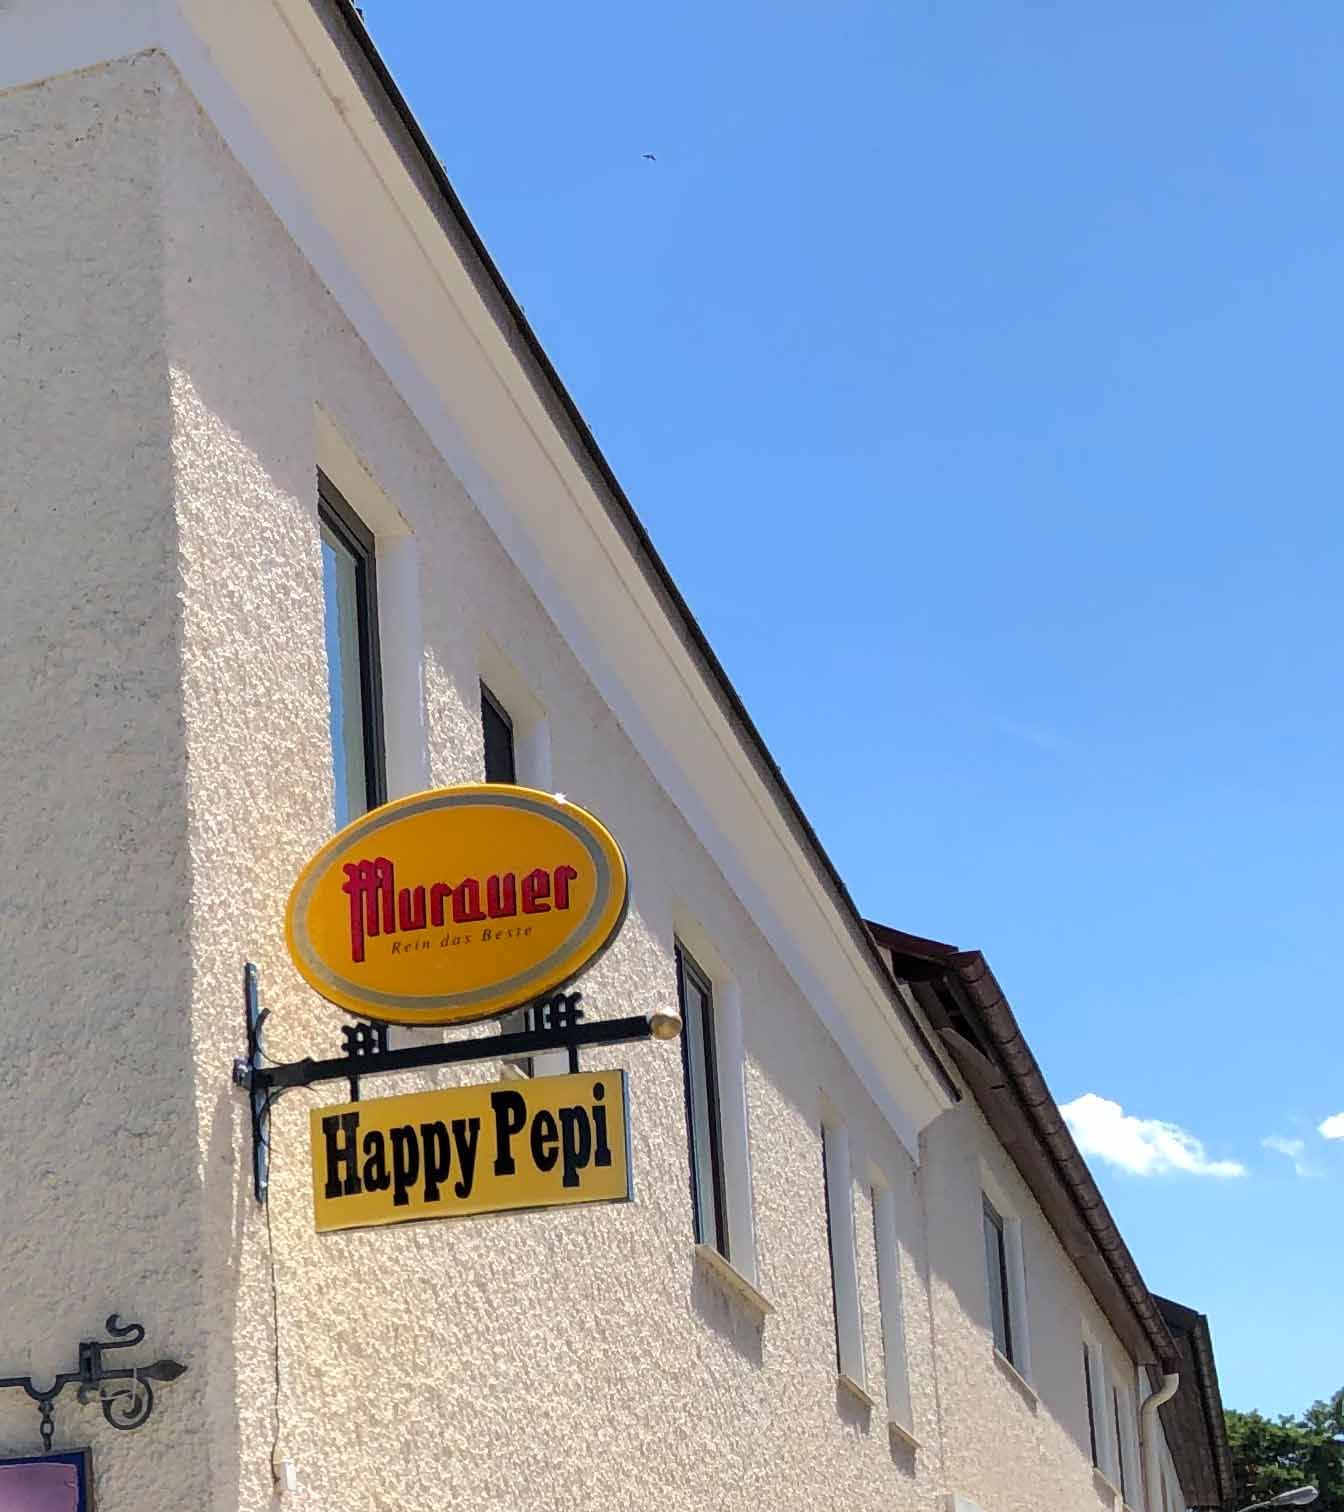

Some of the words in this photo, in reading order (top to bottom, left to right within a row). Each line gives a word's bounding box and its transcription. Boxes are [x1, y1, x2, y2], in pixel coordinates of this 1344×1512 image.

[342, 857, 578, 963] Murauer
[391, 940, 431, 955] Rein
[440, 932, 472, 948] das
[482, 925, 533, 943] Beste
[322, 1110, 481, 1207] Happy
[491, 1082, 612, 1188] Pepi
